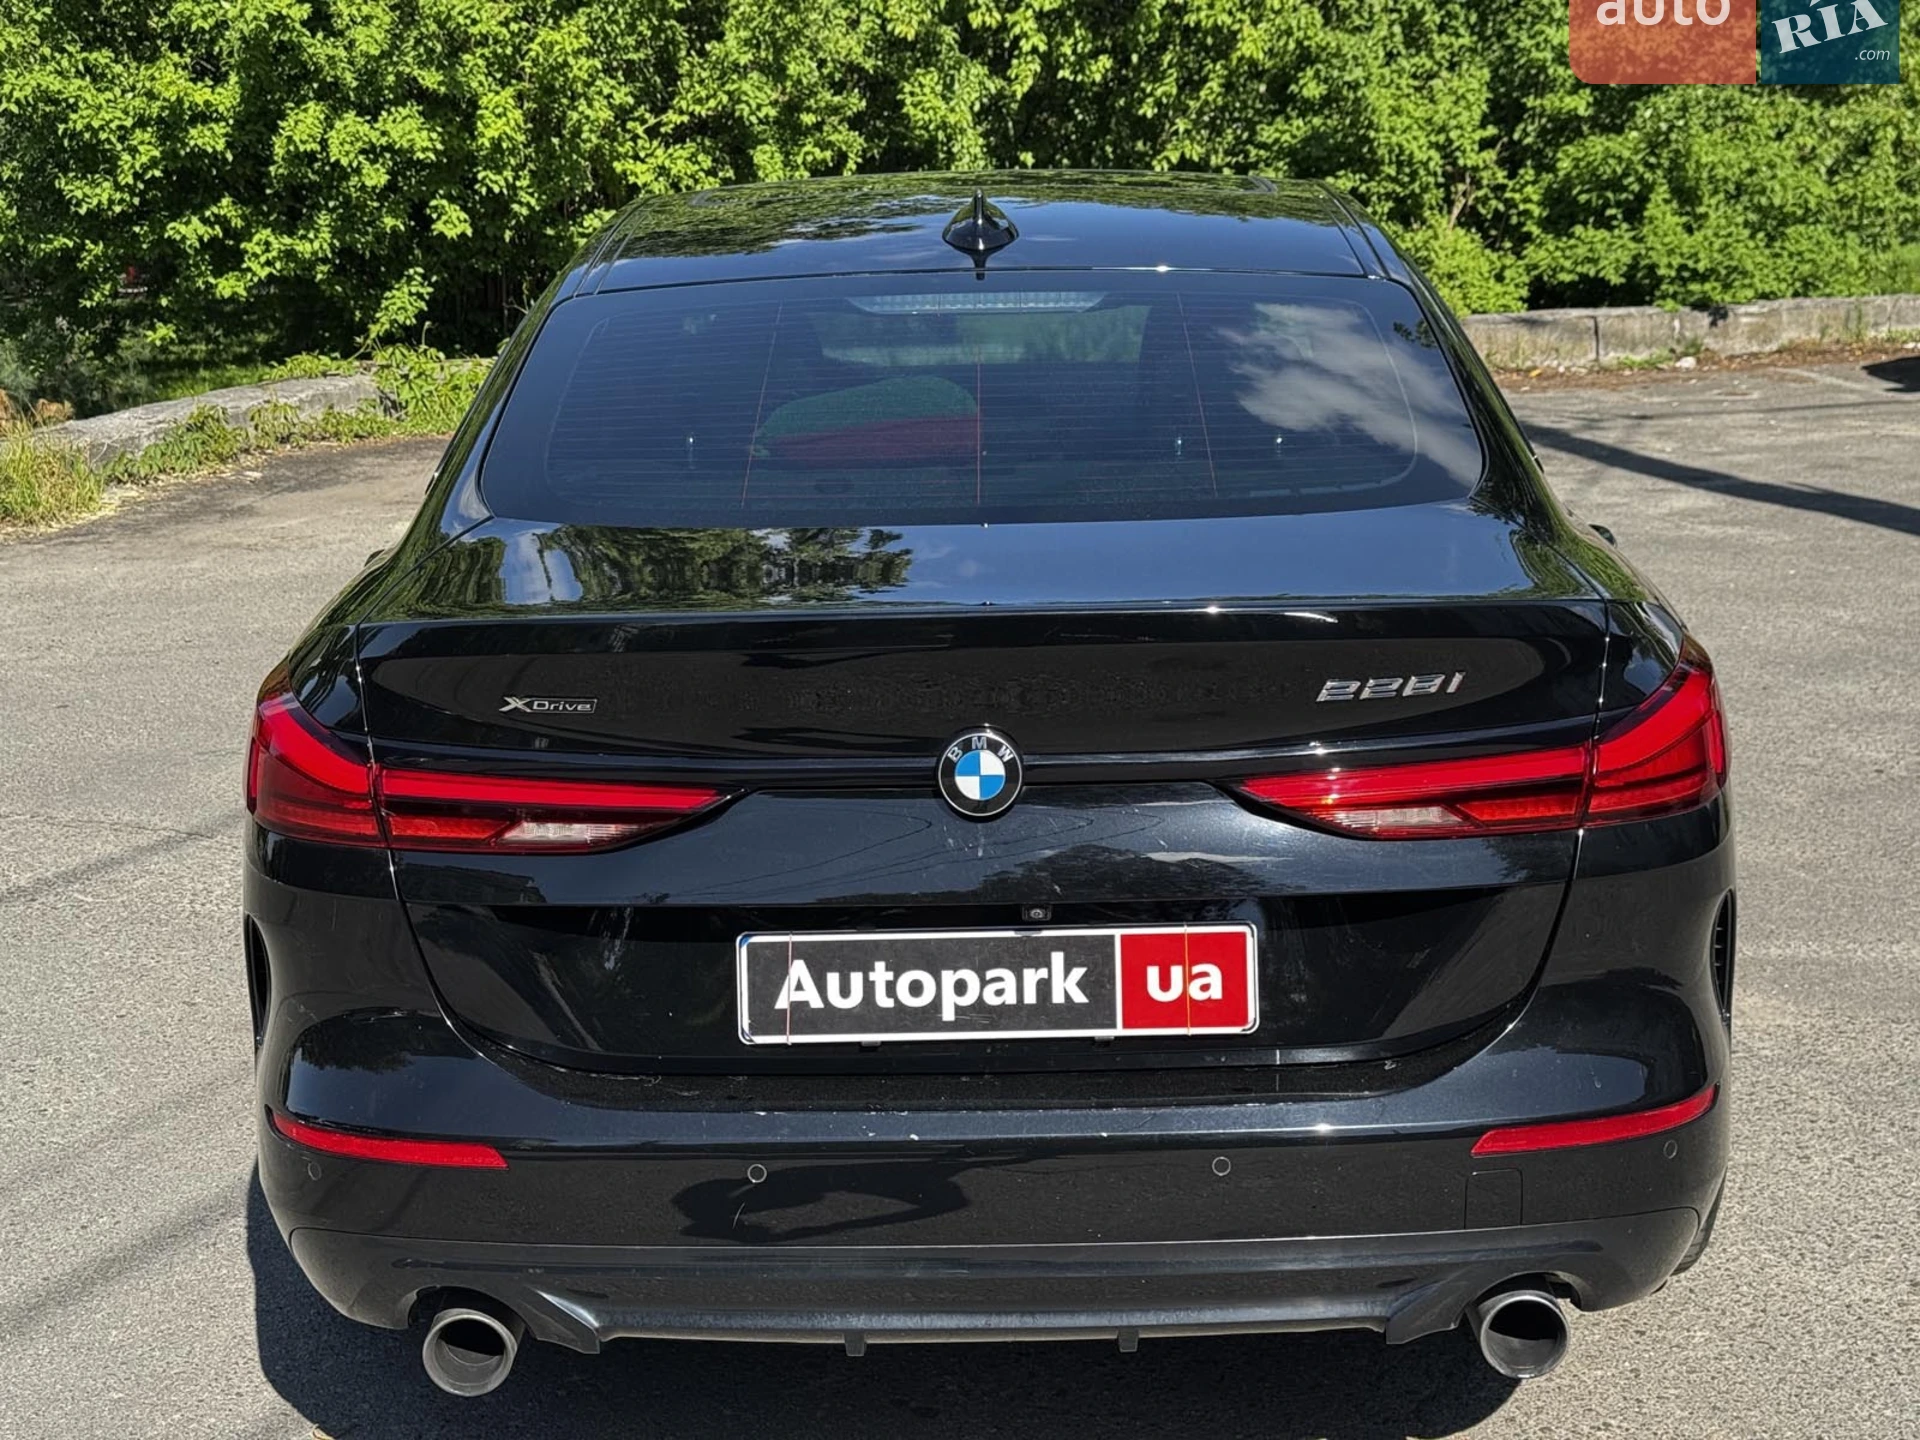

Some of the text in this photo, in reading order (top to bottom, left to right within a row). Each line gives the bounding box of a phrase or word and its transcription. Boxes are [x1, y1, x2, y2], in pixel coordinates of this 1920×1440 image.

[947, 736, 1015, 763] BMW
[774, 951, 1223, 1021] Autopark ua
